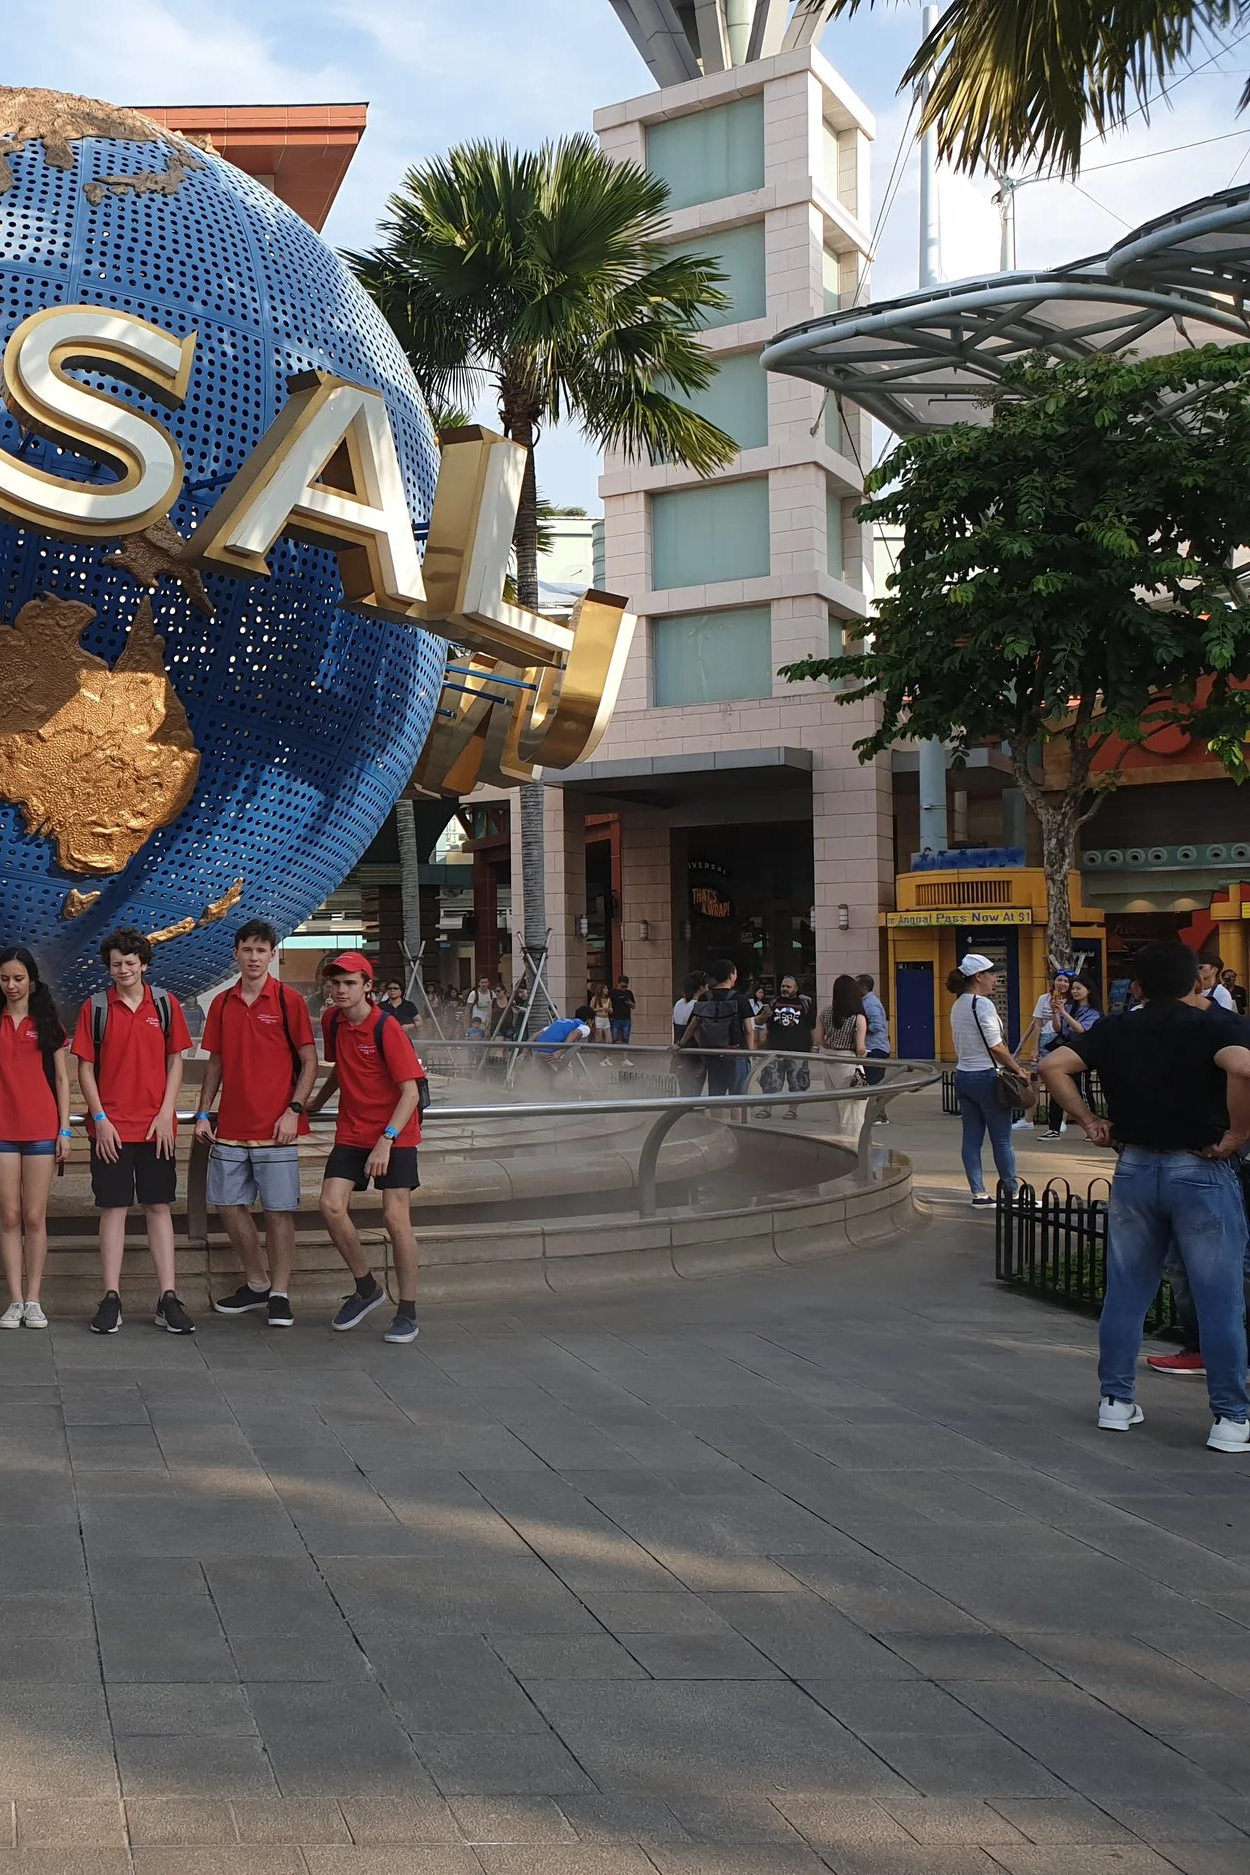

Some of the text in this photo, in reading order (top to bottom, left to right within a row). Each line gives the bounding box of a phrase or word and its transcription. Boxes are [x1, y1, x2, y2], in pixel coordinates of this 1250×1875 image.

[899, 914, 932, 925] Annual
[936, 912, 967, 923] Pass
[972, 912, 999, 922] Now
